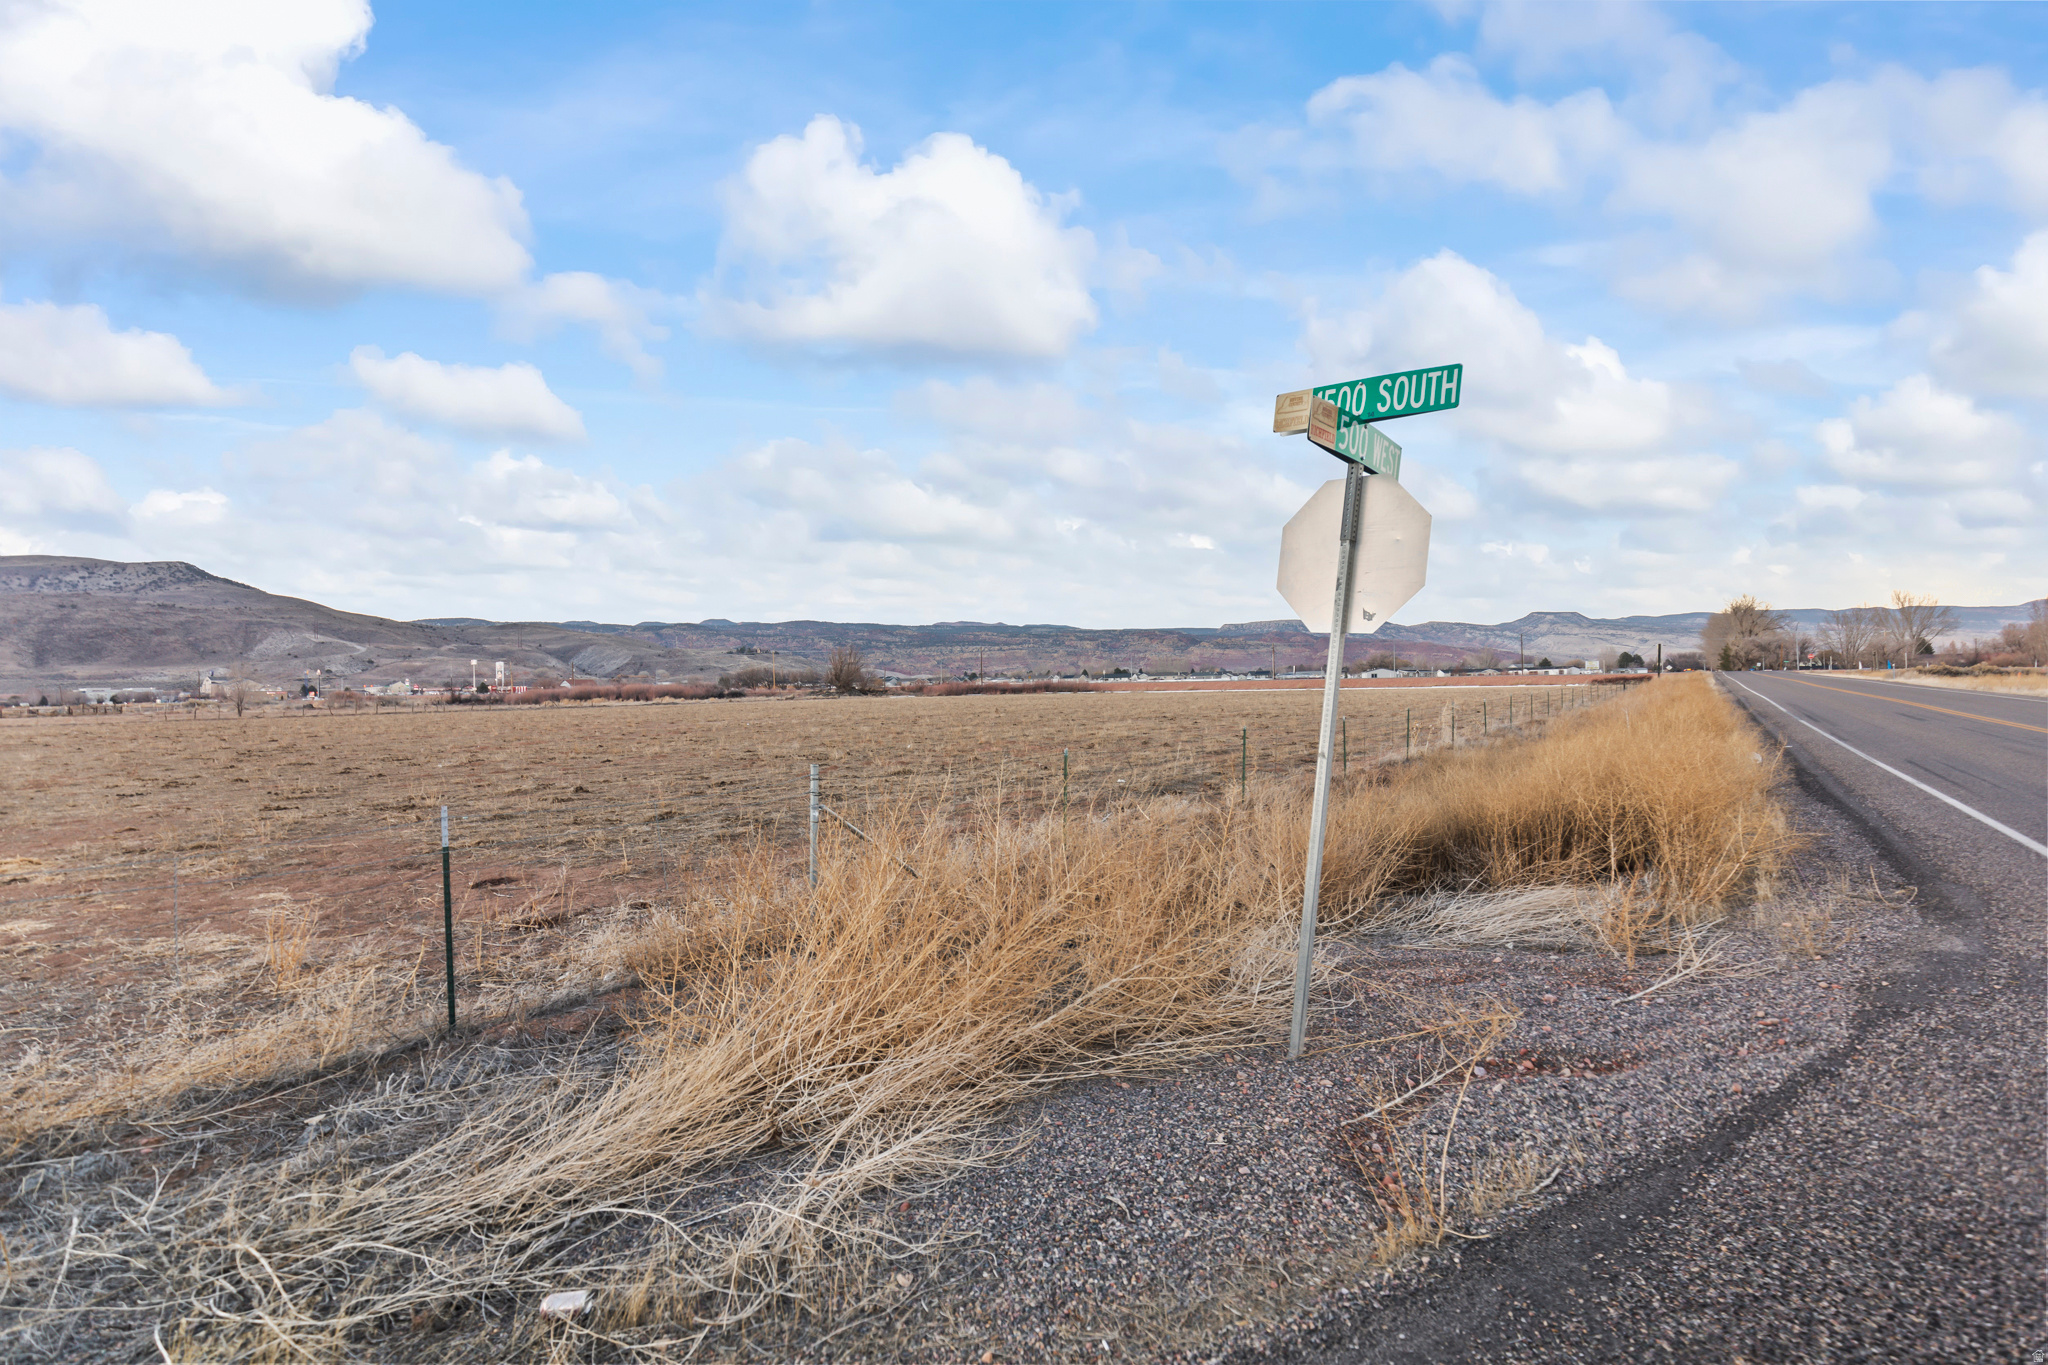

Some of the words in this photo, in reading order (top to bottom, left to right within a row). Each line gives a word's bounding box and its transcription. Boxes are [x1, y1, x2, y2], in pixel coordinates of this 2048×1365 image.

[1377, 368, 1459, 413] SOUTH
[1338, 414, 1369, 461] 500
[1372, 433, 1401, 480] WEST
